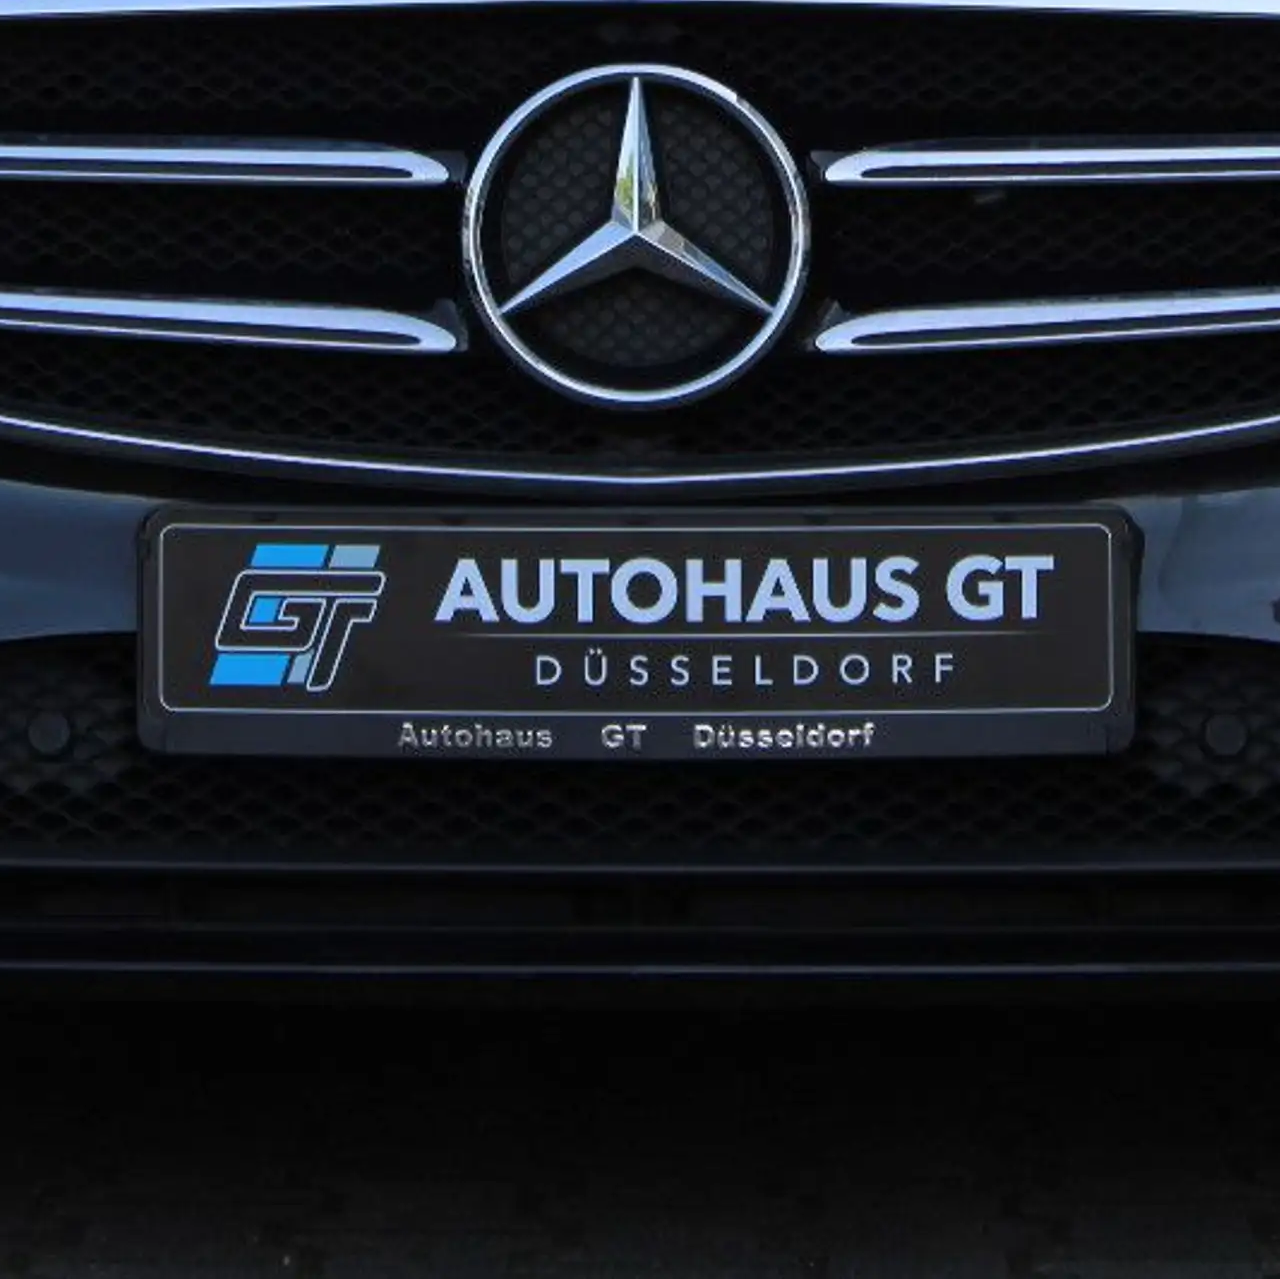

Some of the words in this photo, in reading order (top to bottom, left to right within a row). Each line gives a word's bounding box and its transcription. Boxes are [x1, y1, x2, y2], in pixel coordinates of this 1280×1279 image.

[433, 555, 920, 624] AUTOHAUS
[945, 554, 1055, 622] GT
[535, 648, 955, 687] DÜSSELDORF
[398, 722, 553, 749] Autohaus
[601, 723, 648, 749] GT
[693, 721, 876, 749] Düsseldorf
